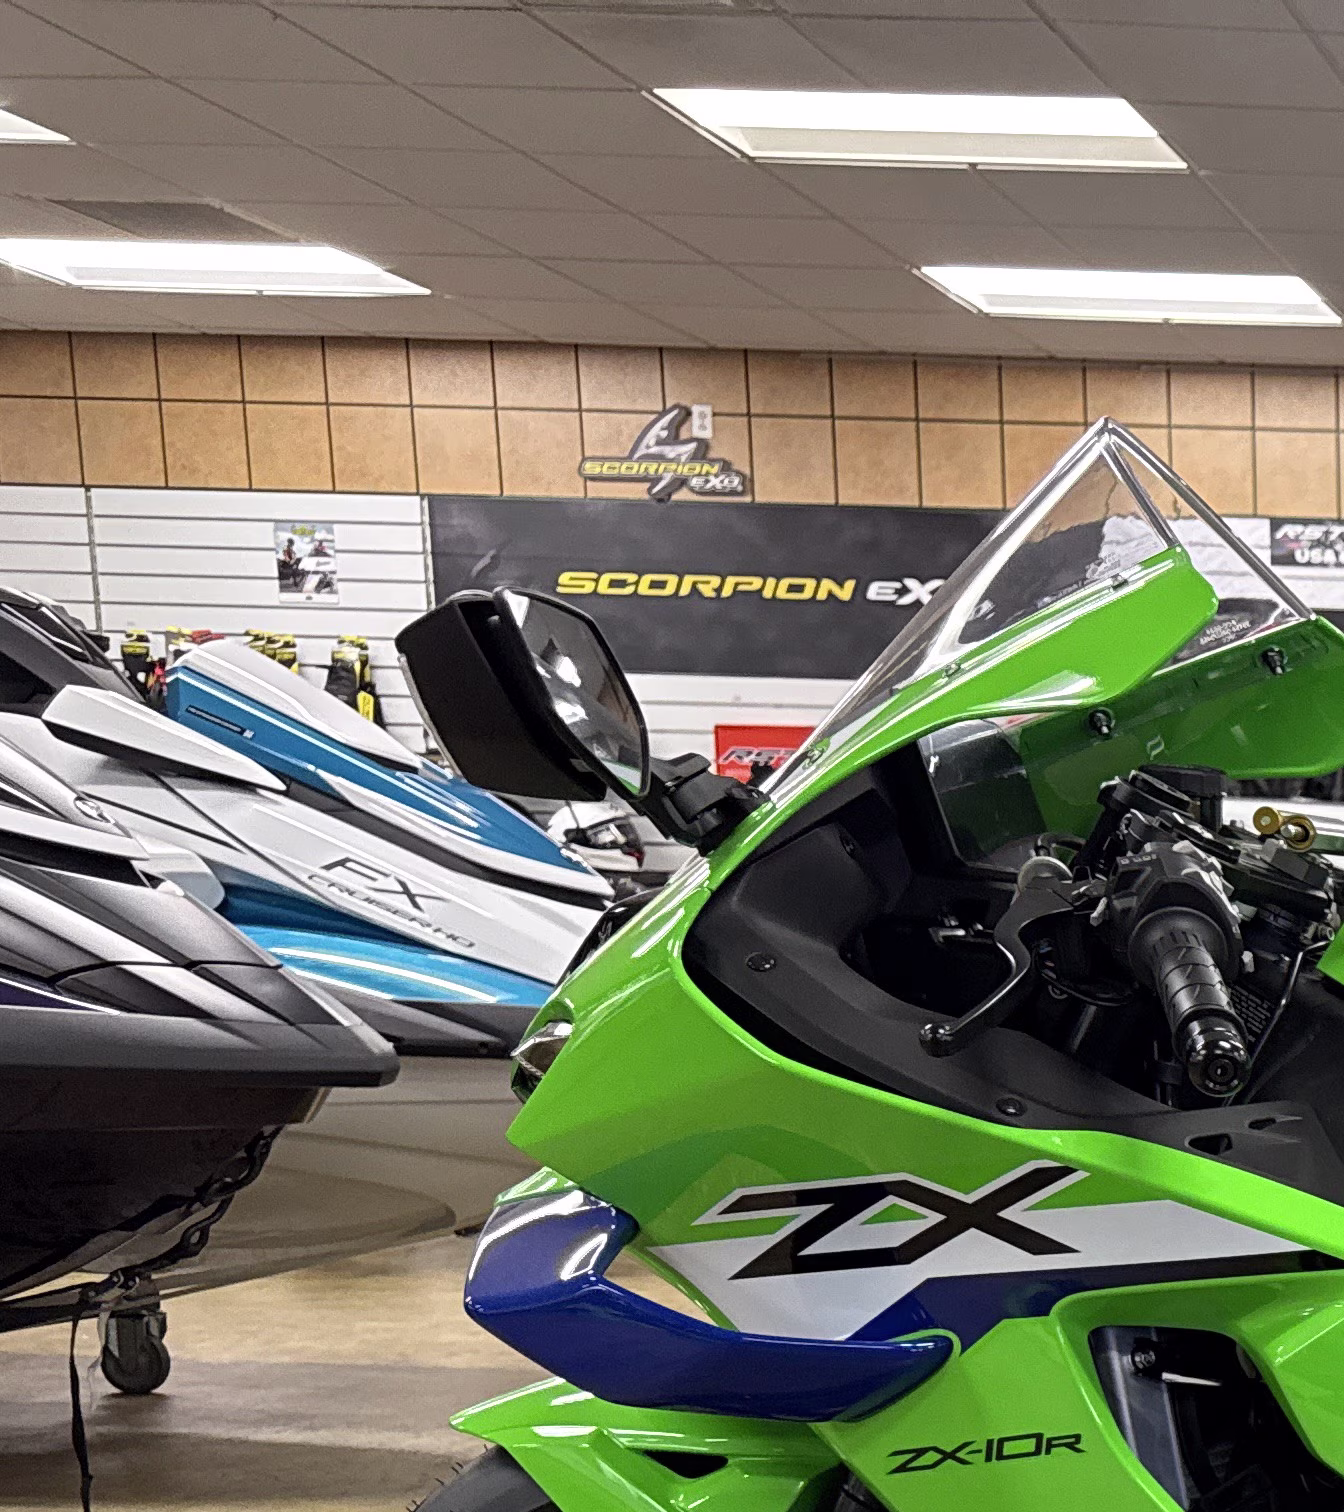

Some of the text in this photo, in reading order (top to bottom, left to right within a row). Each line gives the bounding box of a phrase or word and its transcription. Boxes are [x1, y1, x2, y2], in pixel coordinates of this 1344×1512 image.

[582, 461, 719, 476] SCORPION
[690, 475, 742, 491] EXO
[1293, 549, 1337, 566] USA
[556, 570, 857, 603] SCORPION
[319, 856, 451, 913] FX
[715, 1164, 1082, 1281] ZX
[886, 1432, 1087, 1476] ZX-10R
